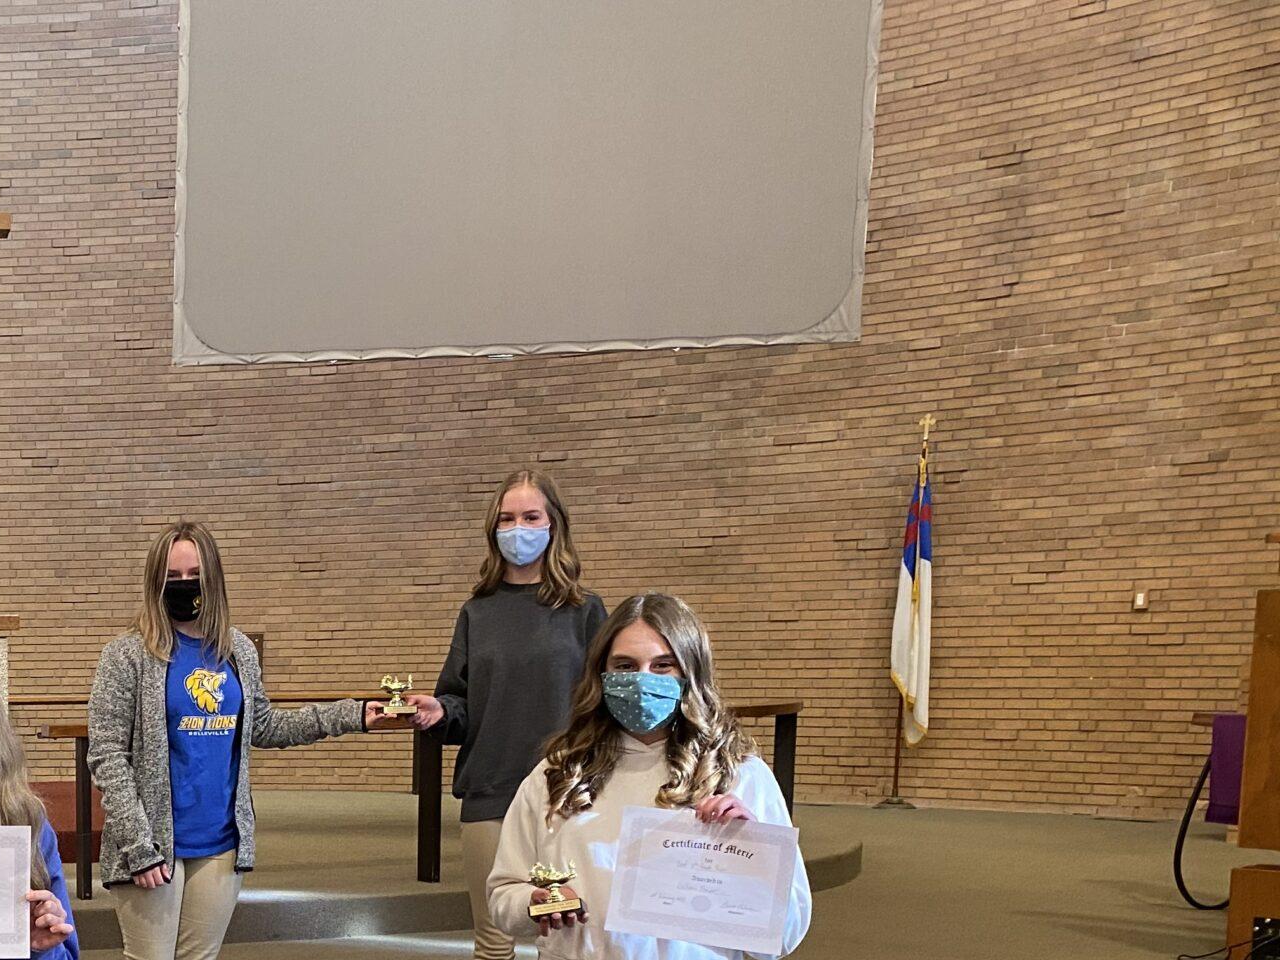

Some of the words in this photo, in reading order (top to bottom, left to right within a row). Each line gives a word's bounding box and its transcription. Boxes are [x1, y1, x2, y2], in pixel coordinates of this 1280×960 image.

[180, 716, 205, 730] ZION
[206, 715, 237, 729] LIONS
[662, 839, 712, 850] Certificate
[713, 842, 723, 851] of
[724, 844, 754, 860] Merit
